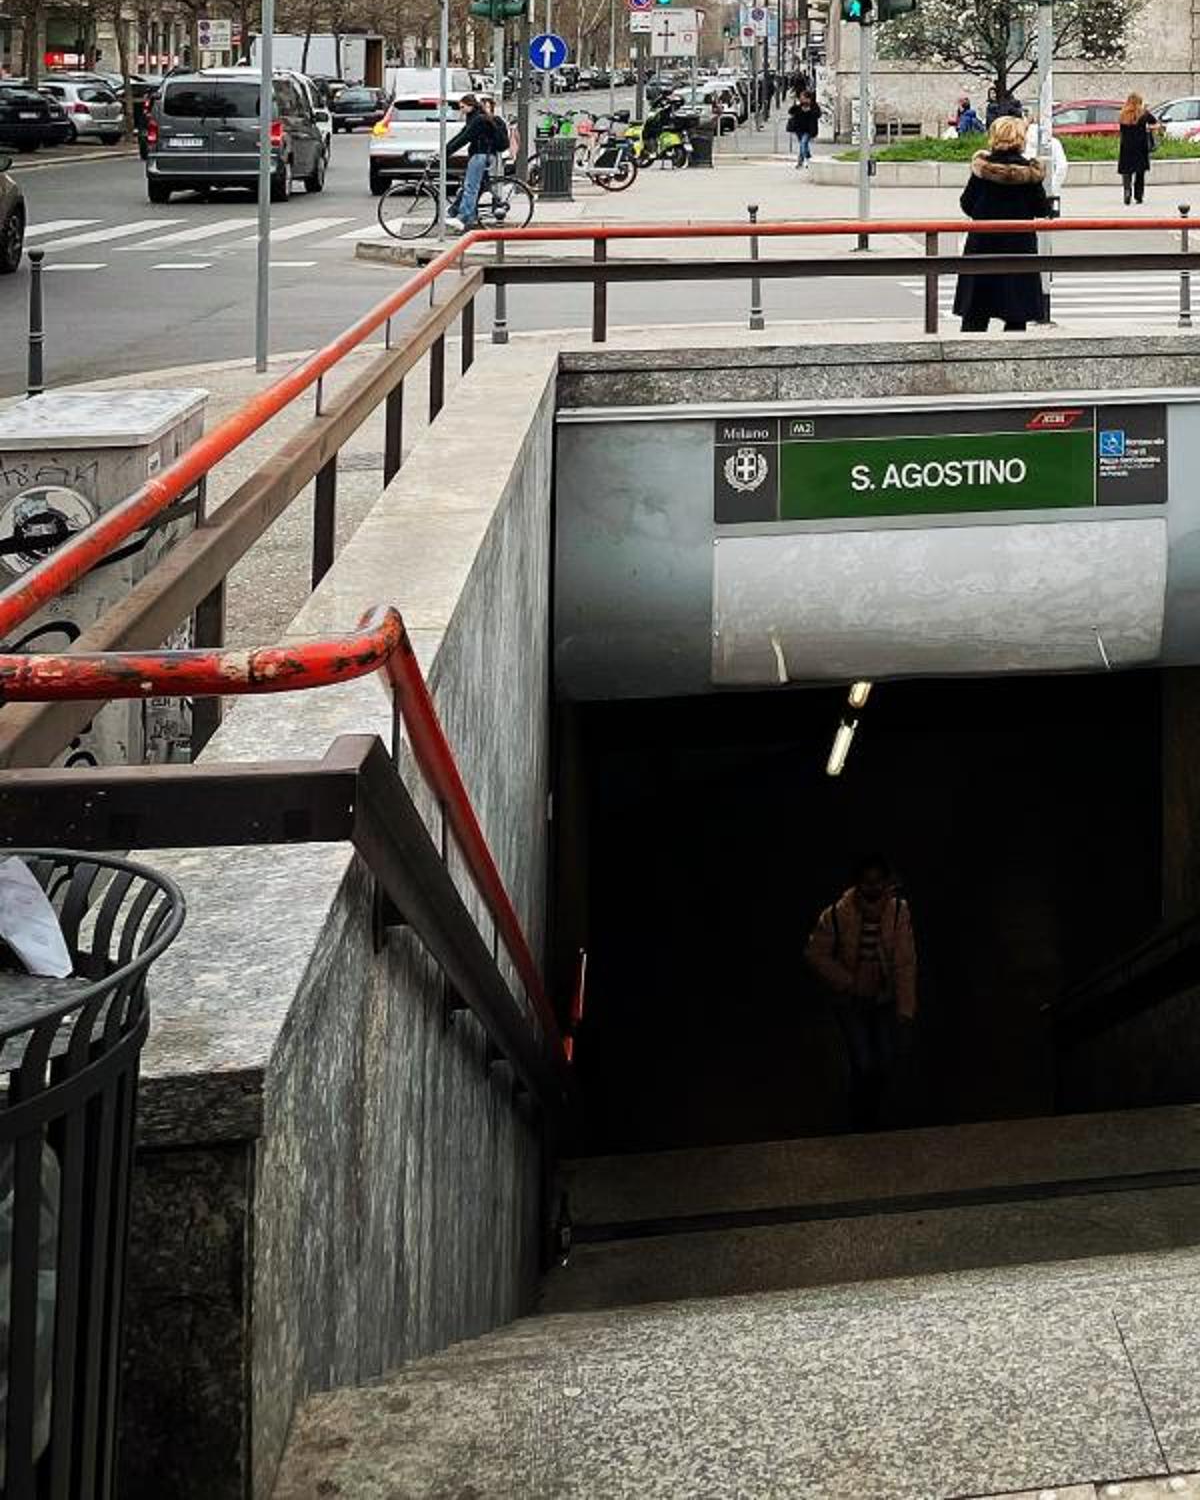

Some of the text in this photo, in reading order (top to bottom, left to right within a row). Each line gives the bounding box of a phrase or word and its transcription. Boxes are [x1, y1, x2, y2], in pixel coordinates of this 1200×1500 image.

[723, 426, 769, 439] Milano
[793, 422, 812, 434] M2
[851, 457, 1027, 490] S. AGOSTINO
